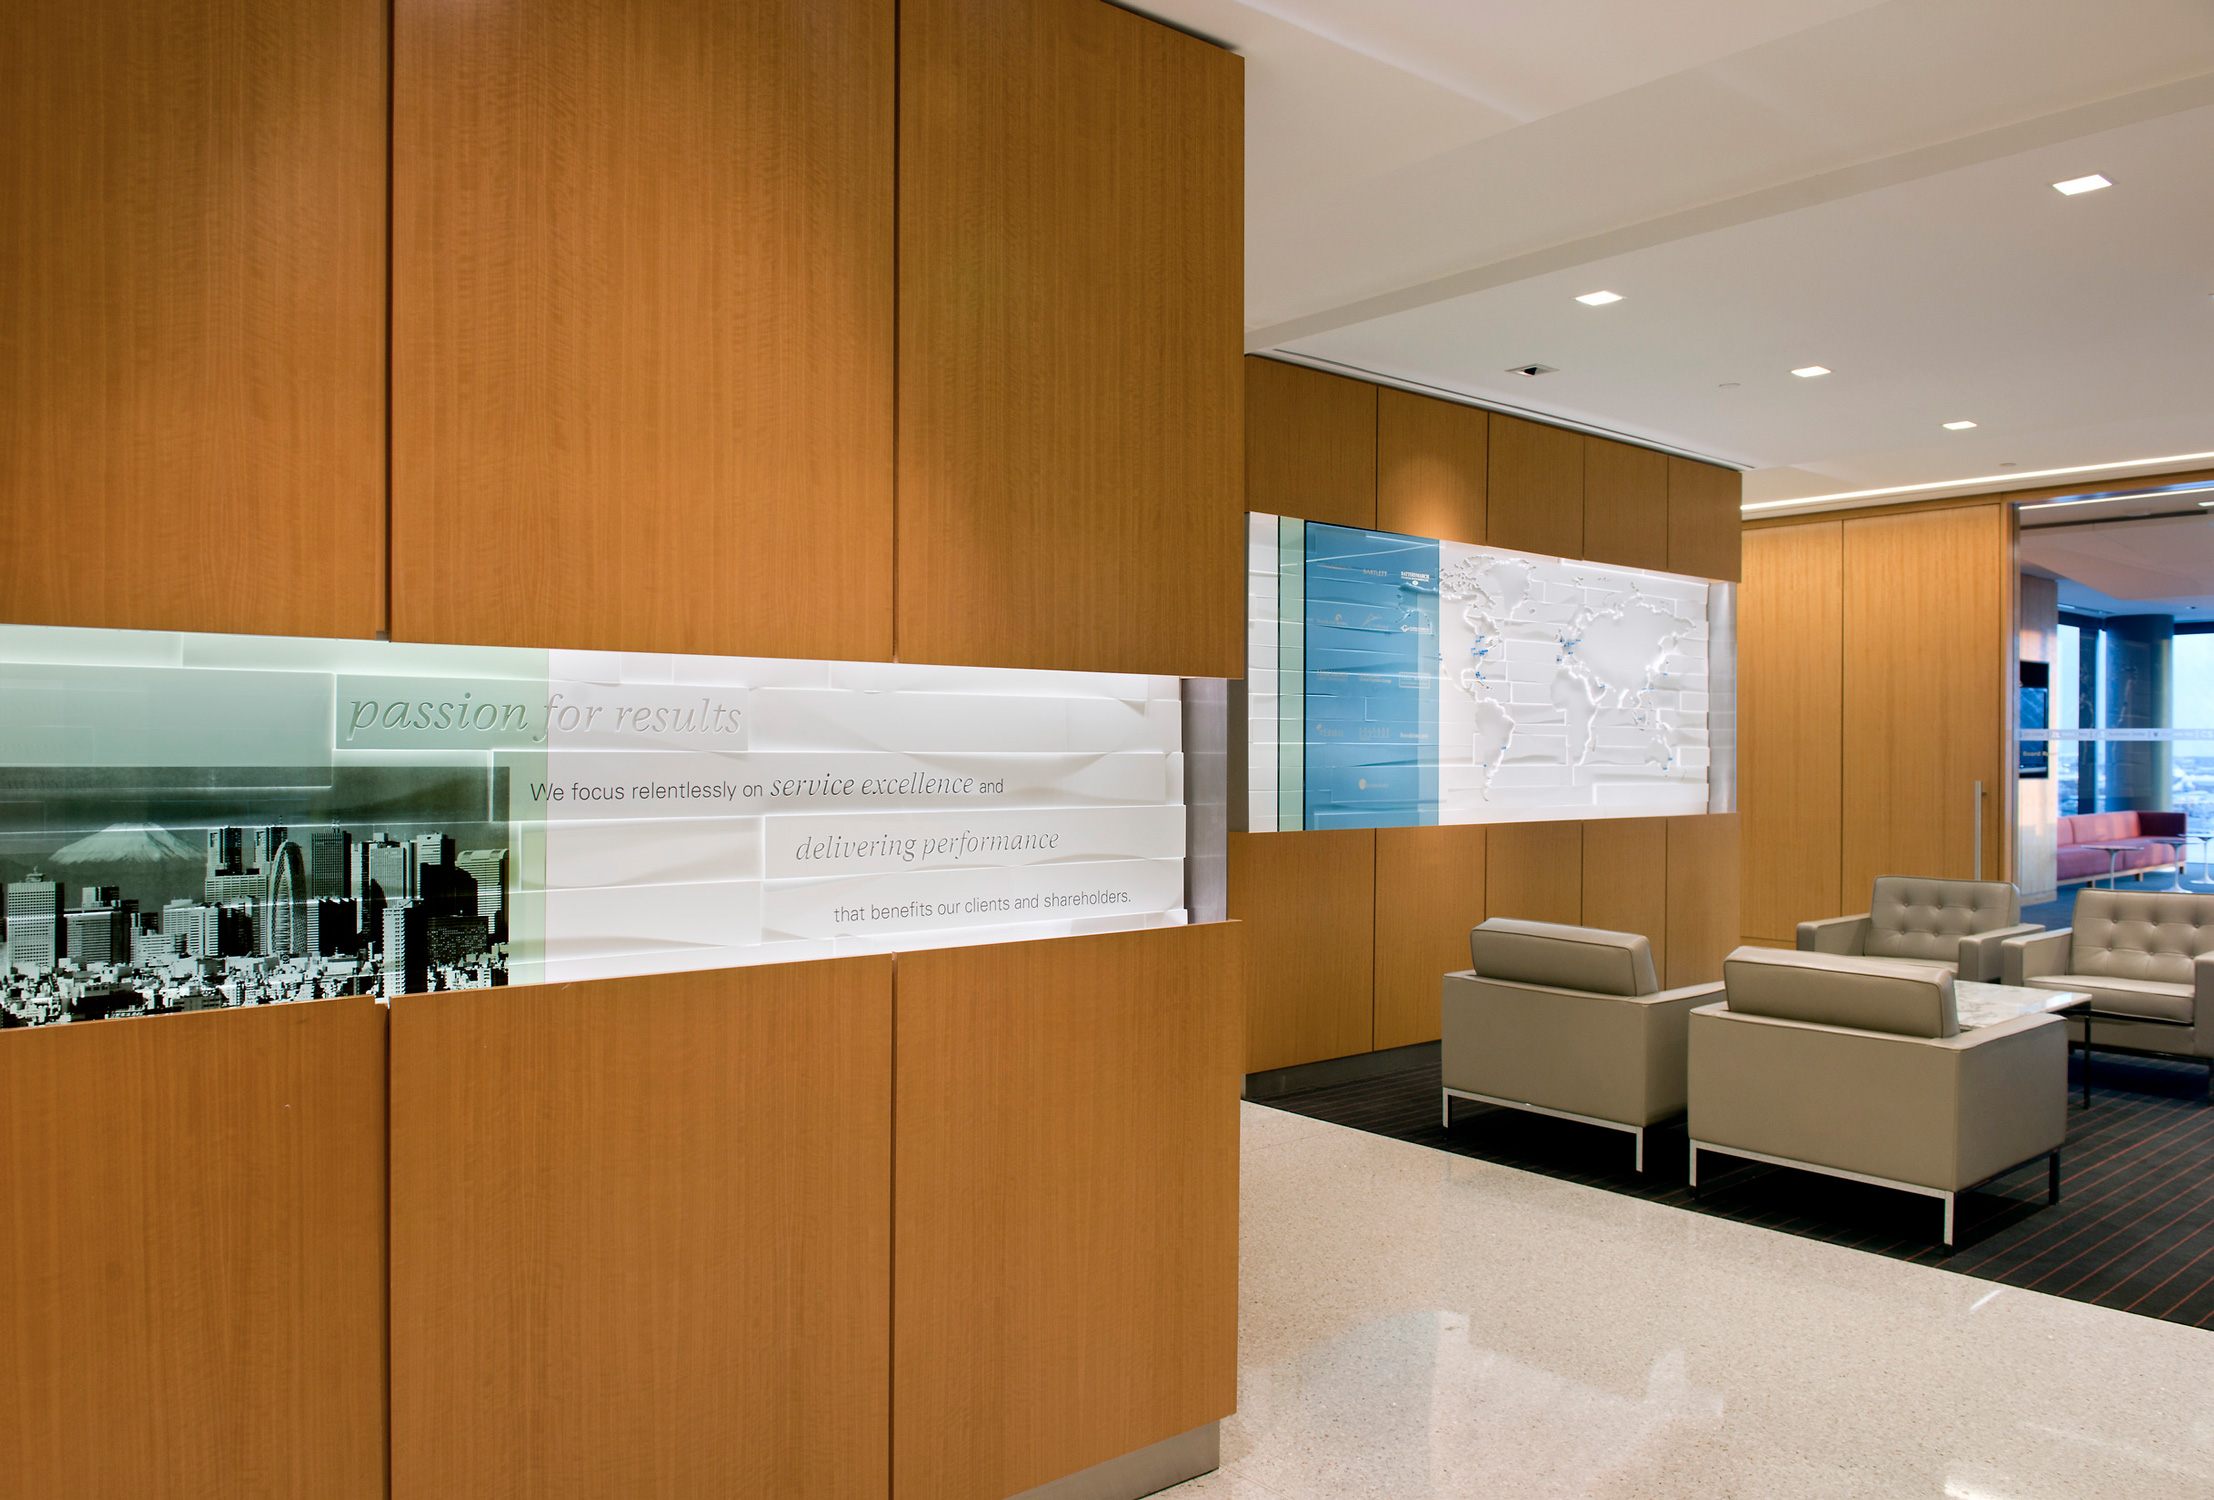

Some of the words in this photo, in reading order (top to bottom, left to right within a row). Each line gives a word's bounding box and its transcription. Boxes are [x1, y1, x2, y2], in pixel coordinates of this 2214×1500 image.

[347, 692, 528, 741] passion
[533, 693, 603, 742] for
[615, 697, 742, 735] results
[530, 782, 565, 801] We
[571, 782, 625, 801] focus
[631, 780, 737, 802] relentlessly
[742, 783, 764, 798] on
[770, 772, 855, 798] service
[861, 771, 975, 796] excellence
[979, 778, 1004, 794] and
[796, 832, 917, 862] delivering
[921, 829, 1060, 861] performance
[833, 905, 865, 923] that
[870, 900, 933, 921] benefits
[937, 901, 961, 916] our
[964, 895, 1010, 914] clients
[1014, 893, 1040, 909] and
[1043, 889, 1132, 908] shareholders.
